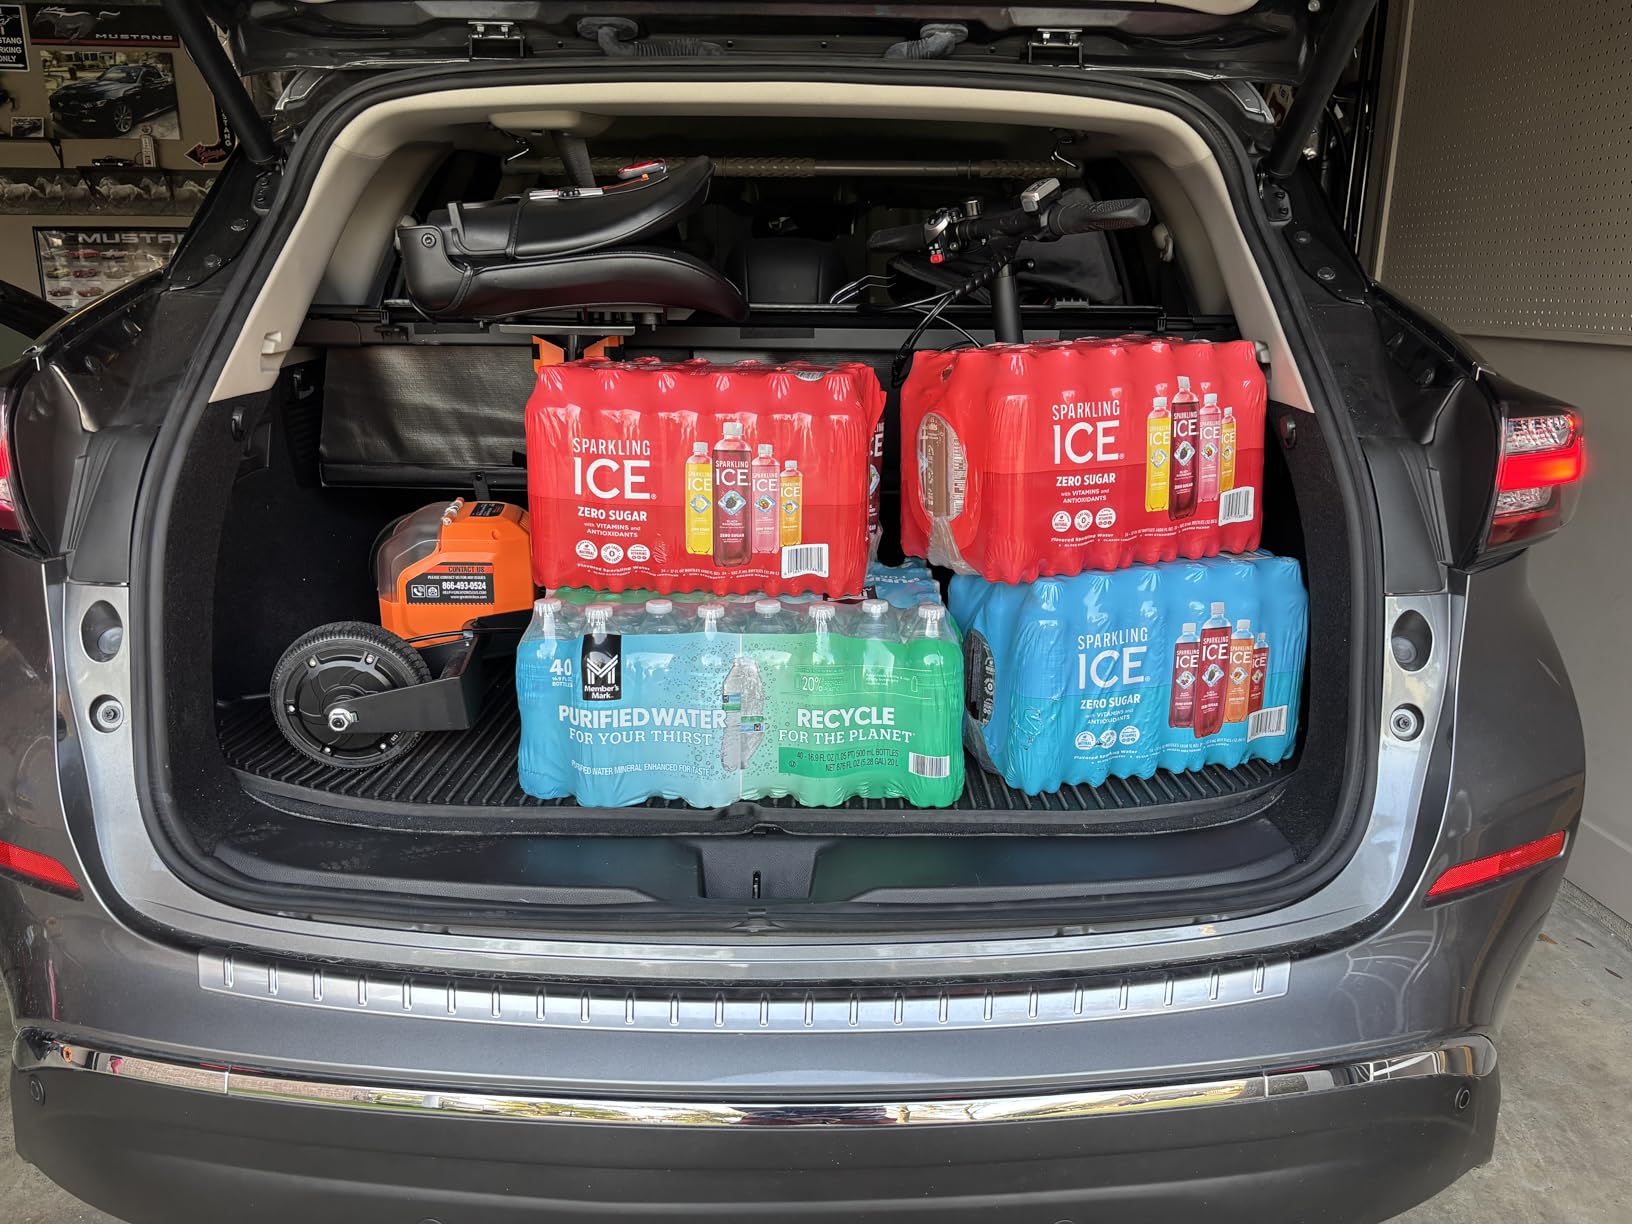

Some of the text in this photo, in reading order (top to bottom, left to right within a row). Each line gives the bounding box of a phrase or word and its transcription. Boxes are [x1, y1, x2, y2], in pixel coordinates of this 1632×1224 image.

[1051, 399, 1120, 421] SPARKLING
[1173, 419, 1198, 438] ICE
[1200, 426, 1220, 440] ICE
[1052, 420, 1120, 465] ICE
[1149, 431, 1170, 446] ICE
[573, 437, 651, 456] SPARKLING
[715, 460, 749, 468] SPARKLING
[574, 456, 651, 500] ICE
[716, 468, 749, 486] ICE
[1056, 472, 1116, 487] ZERO SUGAR
[687, 478, 713, 492] ICE
[752, 479, 778, 492] ICE
[780, 487, 801, 497] ICE
[1072, 488, 1100, 496] VITAMINS
[1062, 495, 1107, 504] ANTIOXIDANTS
[577, 505, 648, 522] ZERO SUGAR
[586, 528, 638, 538] ANTIOXIDANTS
[596, 522, 630, 531] VITAMINS
[442, 581, 487, 590] 866-493-0524
[1077, 626, 1149, 650] SPARKLING
[1202, 643, 1229, 662] ICE
[1230, 651, 1253, 665] ICE
[549, 658, 572, 676] 40
[1078, 645, 1148, 690] ICE
[1176, 655, 1199, 669] ICE
[584, 684, 619, 692] Member's
[801, 676, 823, 692] 20%
[1080, 693, 1142, 710] ZERO SUGAR
[558, 705, 727, 729] PURIFIED WATER
[797, 706, 895, 729] RECYCLE
[569, 728, 713, 746] FOR YOUR THIRST
[778, 728, 913, 745] FOR THE PLANET
[819, 753, 826, 762] FL
[826, 753, 834, 762] OZ
[875, 748, 900, 758] BOTTLES
[592, 767, 613, 776] WATER
[613, 764, 642, 774] MINERAL
[643, 763, 678, 772] ENHANCED
[678, 764, 691, 773] FOR
[691, 766, 710, 776] TASTE
